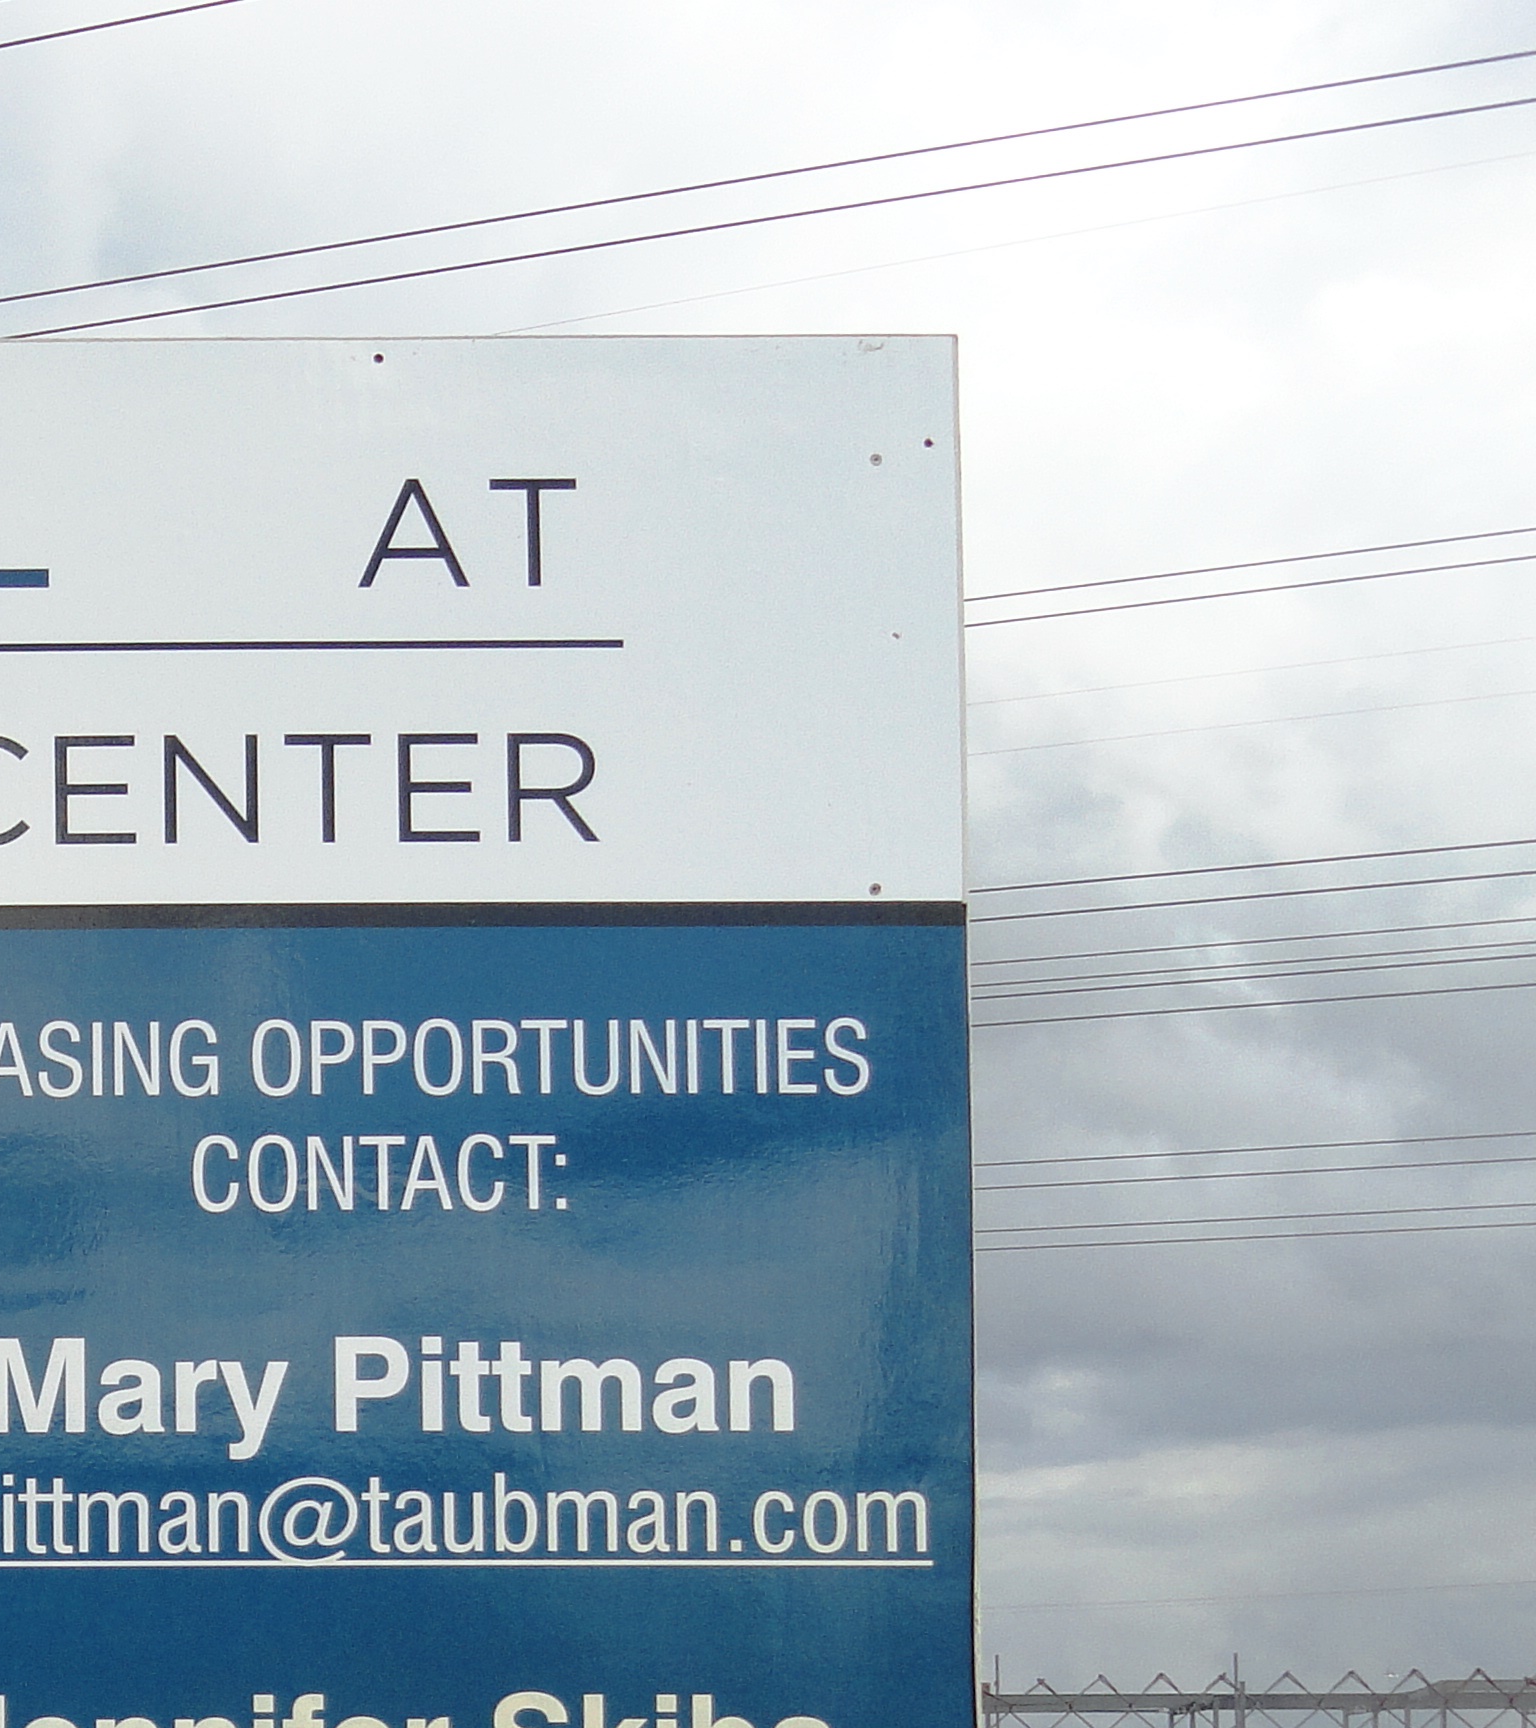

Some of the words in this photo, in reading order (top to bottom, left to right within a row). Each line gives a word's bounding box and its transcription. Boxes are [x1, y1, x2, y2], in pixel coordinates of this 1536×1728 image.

[358, 478, 577, 588] AT
[251, 1017, 870, 1097] OPPORTUNITIES
[192, 1133, 568, 1213] CONTACT:
[334, 1336, 796, 1434] Pittman
